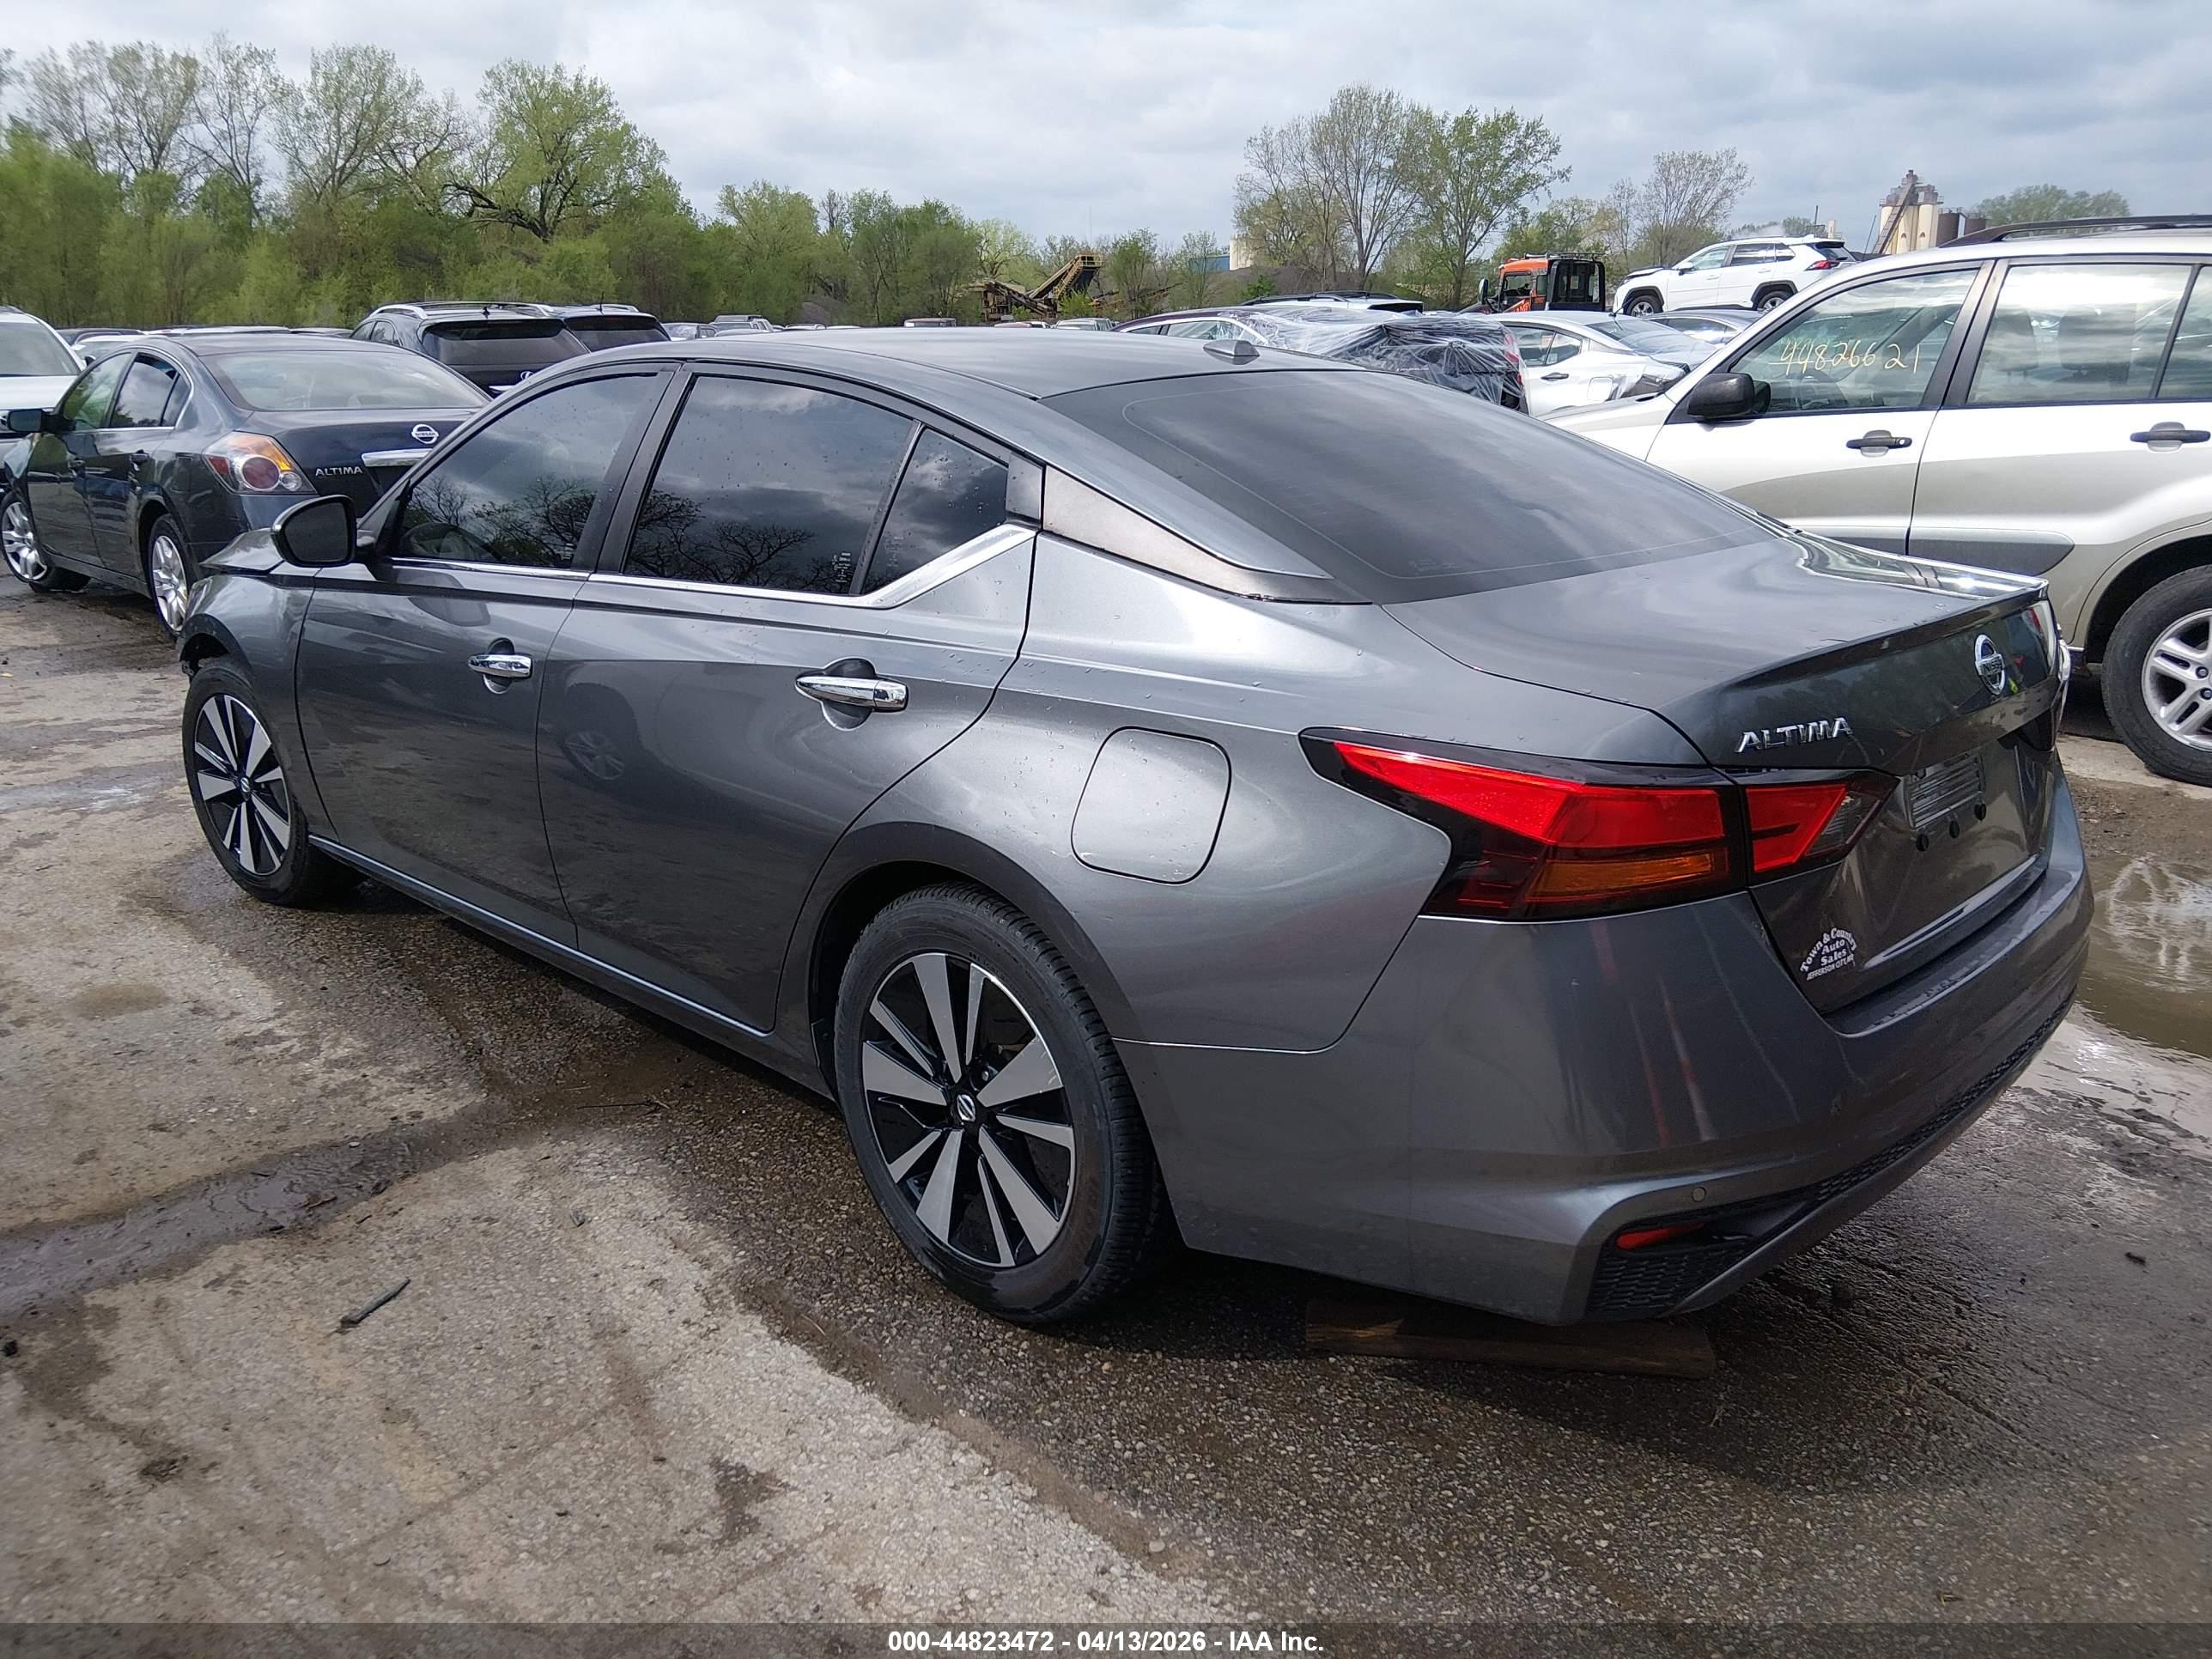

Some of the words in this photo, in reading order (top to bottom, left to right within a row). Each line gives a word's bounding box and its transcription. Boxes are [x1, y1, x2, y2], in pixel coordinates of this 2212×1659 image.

[1769, 339, 1920, 375] 44826621
[315, 466, 363, 477] ALTIMA
[1734, 717, 1853, 753] ALTIMA
[1800, 940, 1823, 971] Town
[1822, 933, 1831, 944] &
[1831, 927, 1856, 951] Country
[1820, 949, 1847, 966] Sales
[1821, 939, 1845, 954] Auto
